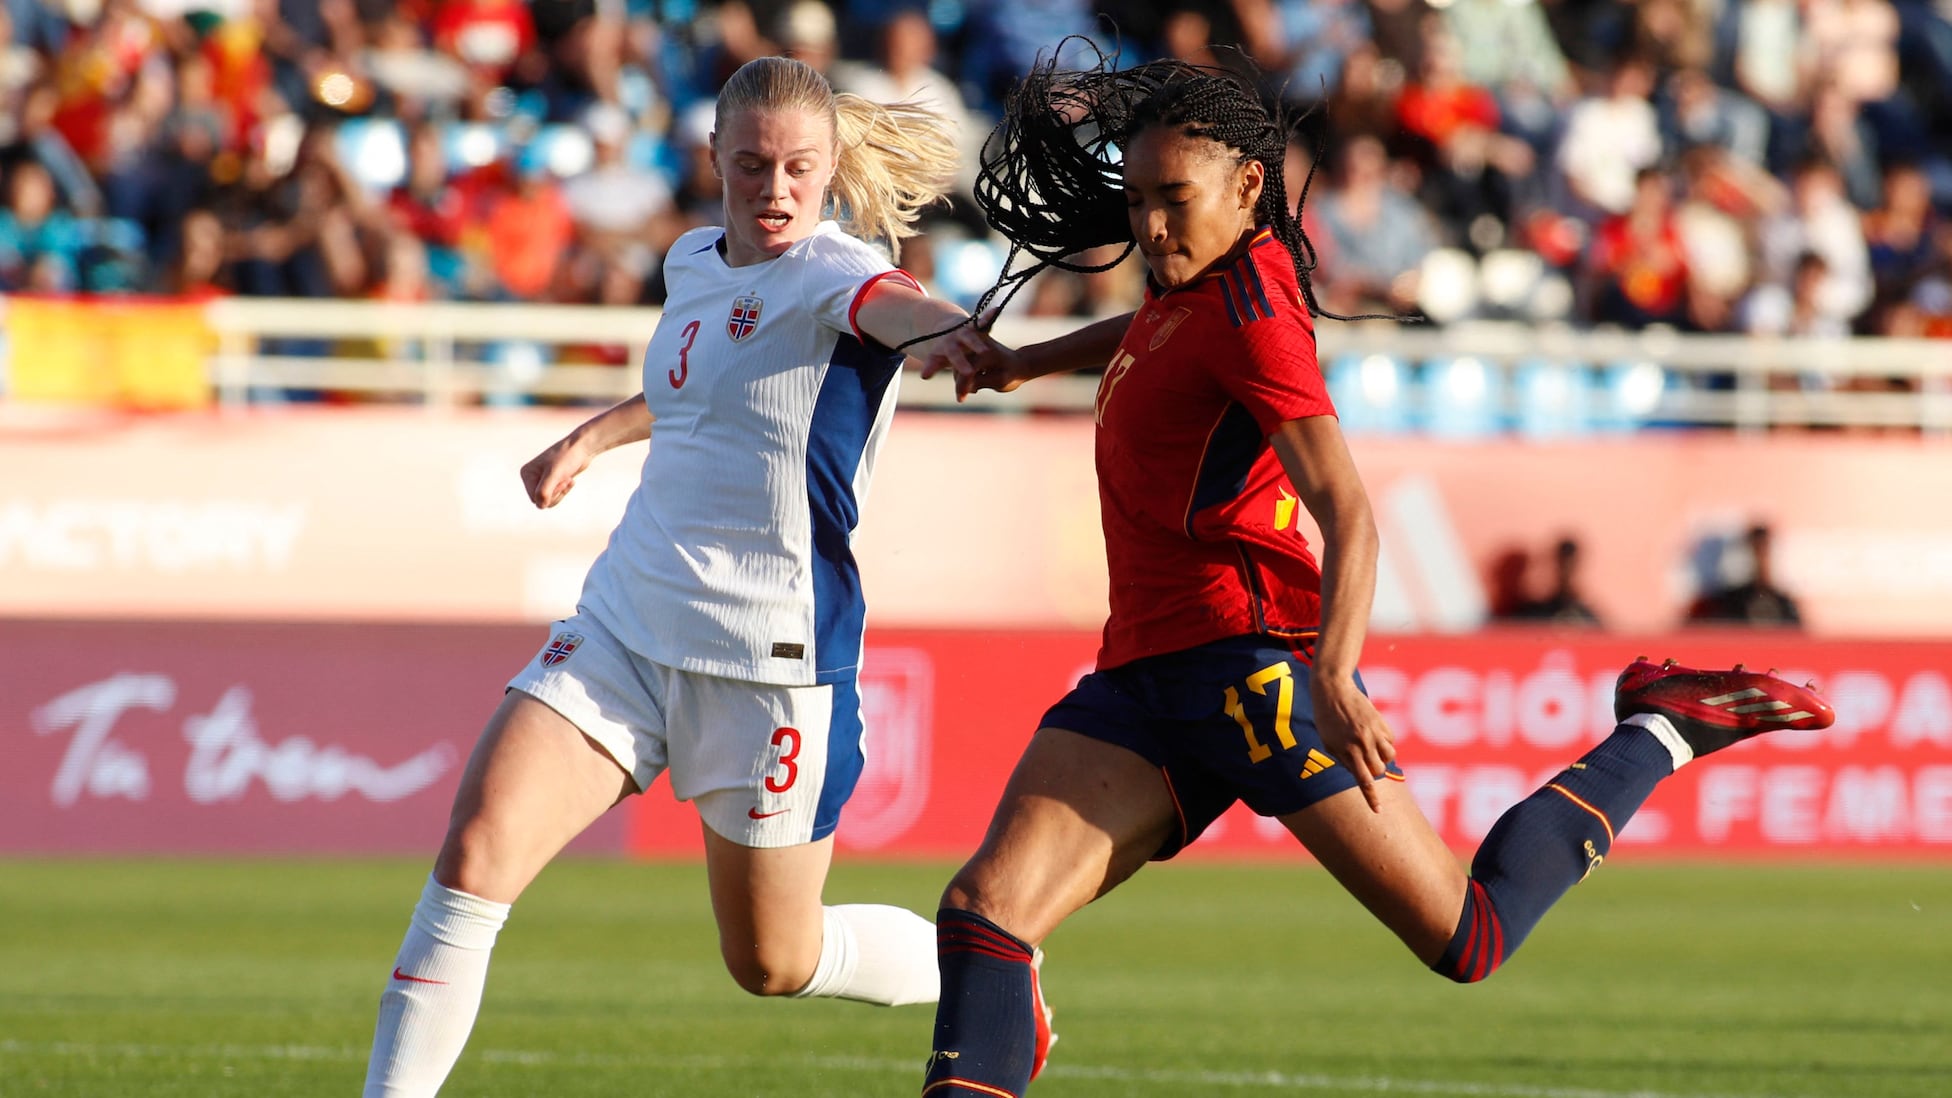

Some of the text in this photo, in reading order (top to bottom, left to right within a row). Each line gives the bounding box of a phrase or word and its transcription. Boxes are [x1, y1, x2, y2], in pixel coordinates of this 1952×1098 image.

[668, 319, 701, 390] 3
[1095, 347, 1136, 428] 17
[1223, 661, 1298, 764] 17
[764, 726, 801, 793] 3
